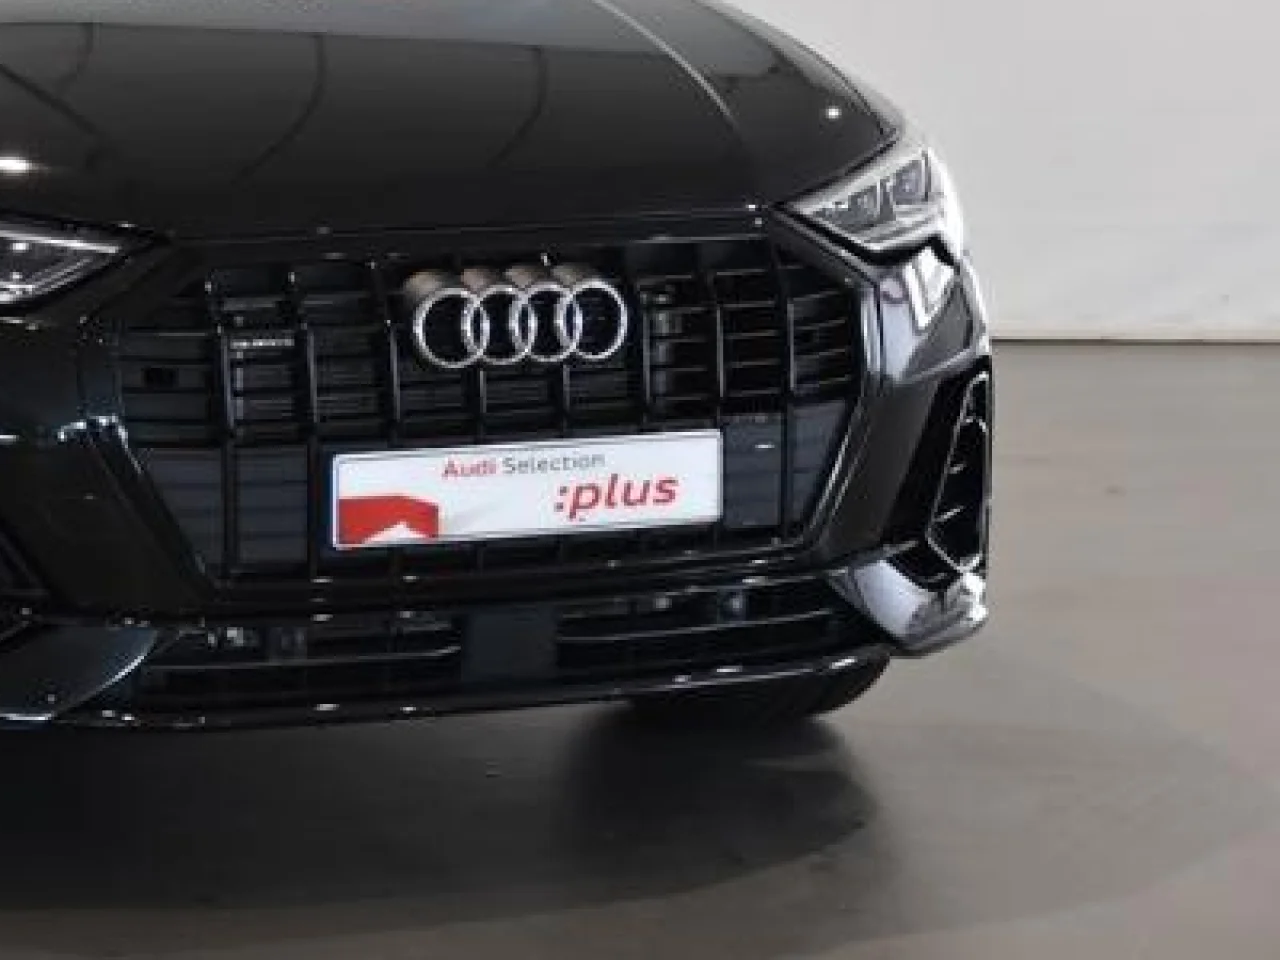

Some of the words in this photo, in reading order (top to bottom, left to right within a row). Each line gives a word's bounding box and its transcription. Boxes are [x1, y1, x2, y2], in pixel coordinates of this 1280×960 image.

[442, 458, 497, 479] Audi
[501, 452, 607, 476] Selection
[554, 473, 680, 519] :plus
